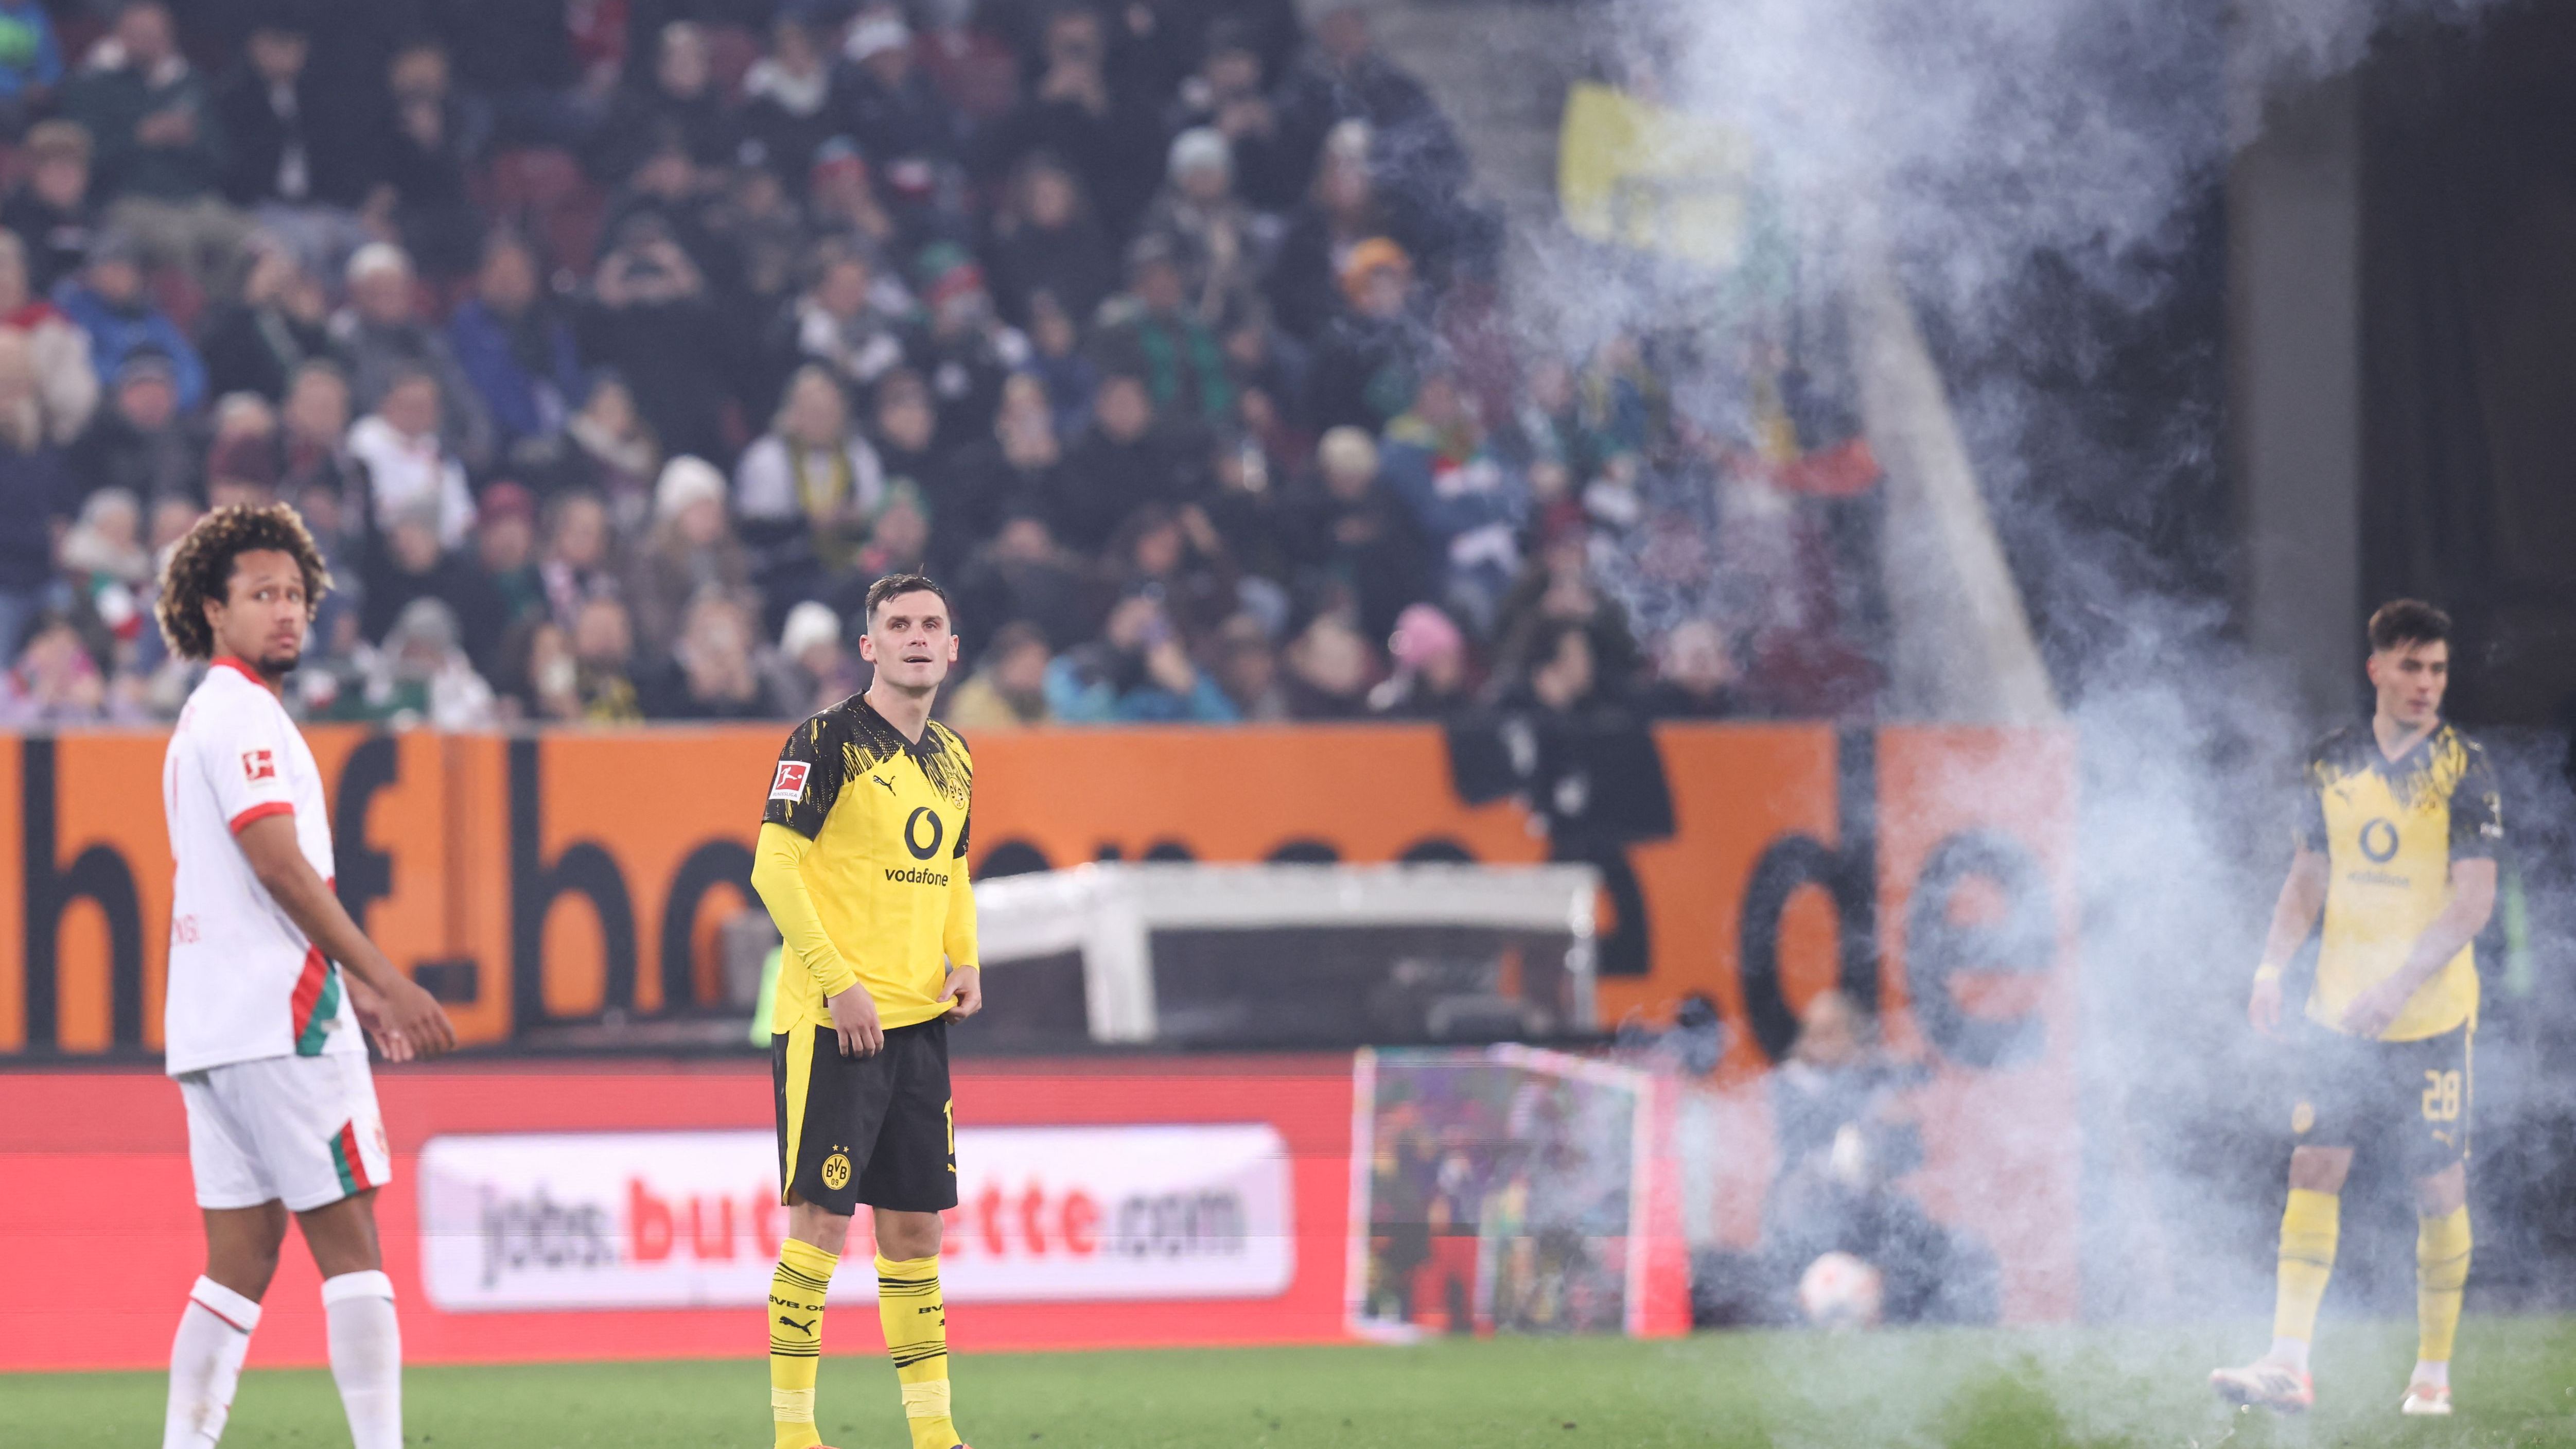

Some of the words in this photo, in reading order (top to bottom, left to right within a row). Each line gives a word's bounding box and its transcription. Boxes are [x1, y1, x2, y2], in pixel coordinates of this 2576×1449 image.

[885, 867, 948, 886] vodafone
[2422, 1069, 2461, 1121] 28
[826, 1158, 847, 1180] BVB
[769, 1294, 799, 1308] BVB
